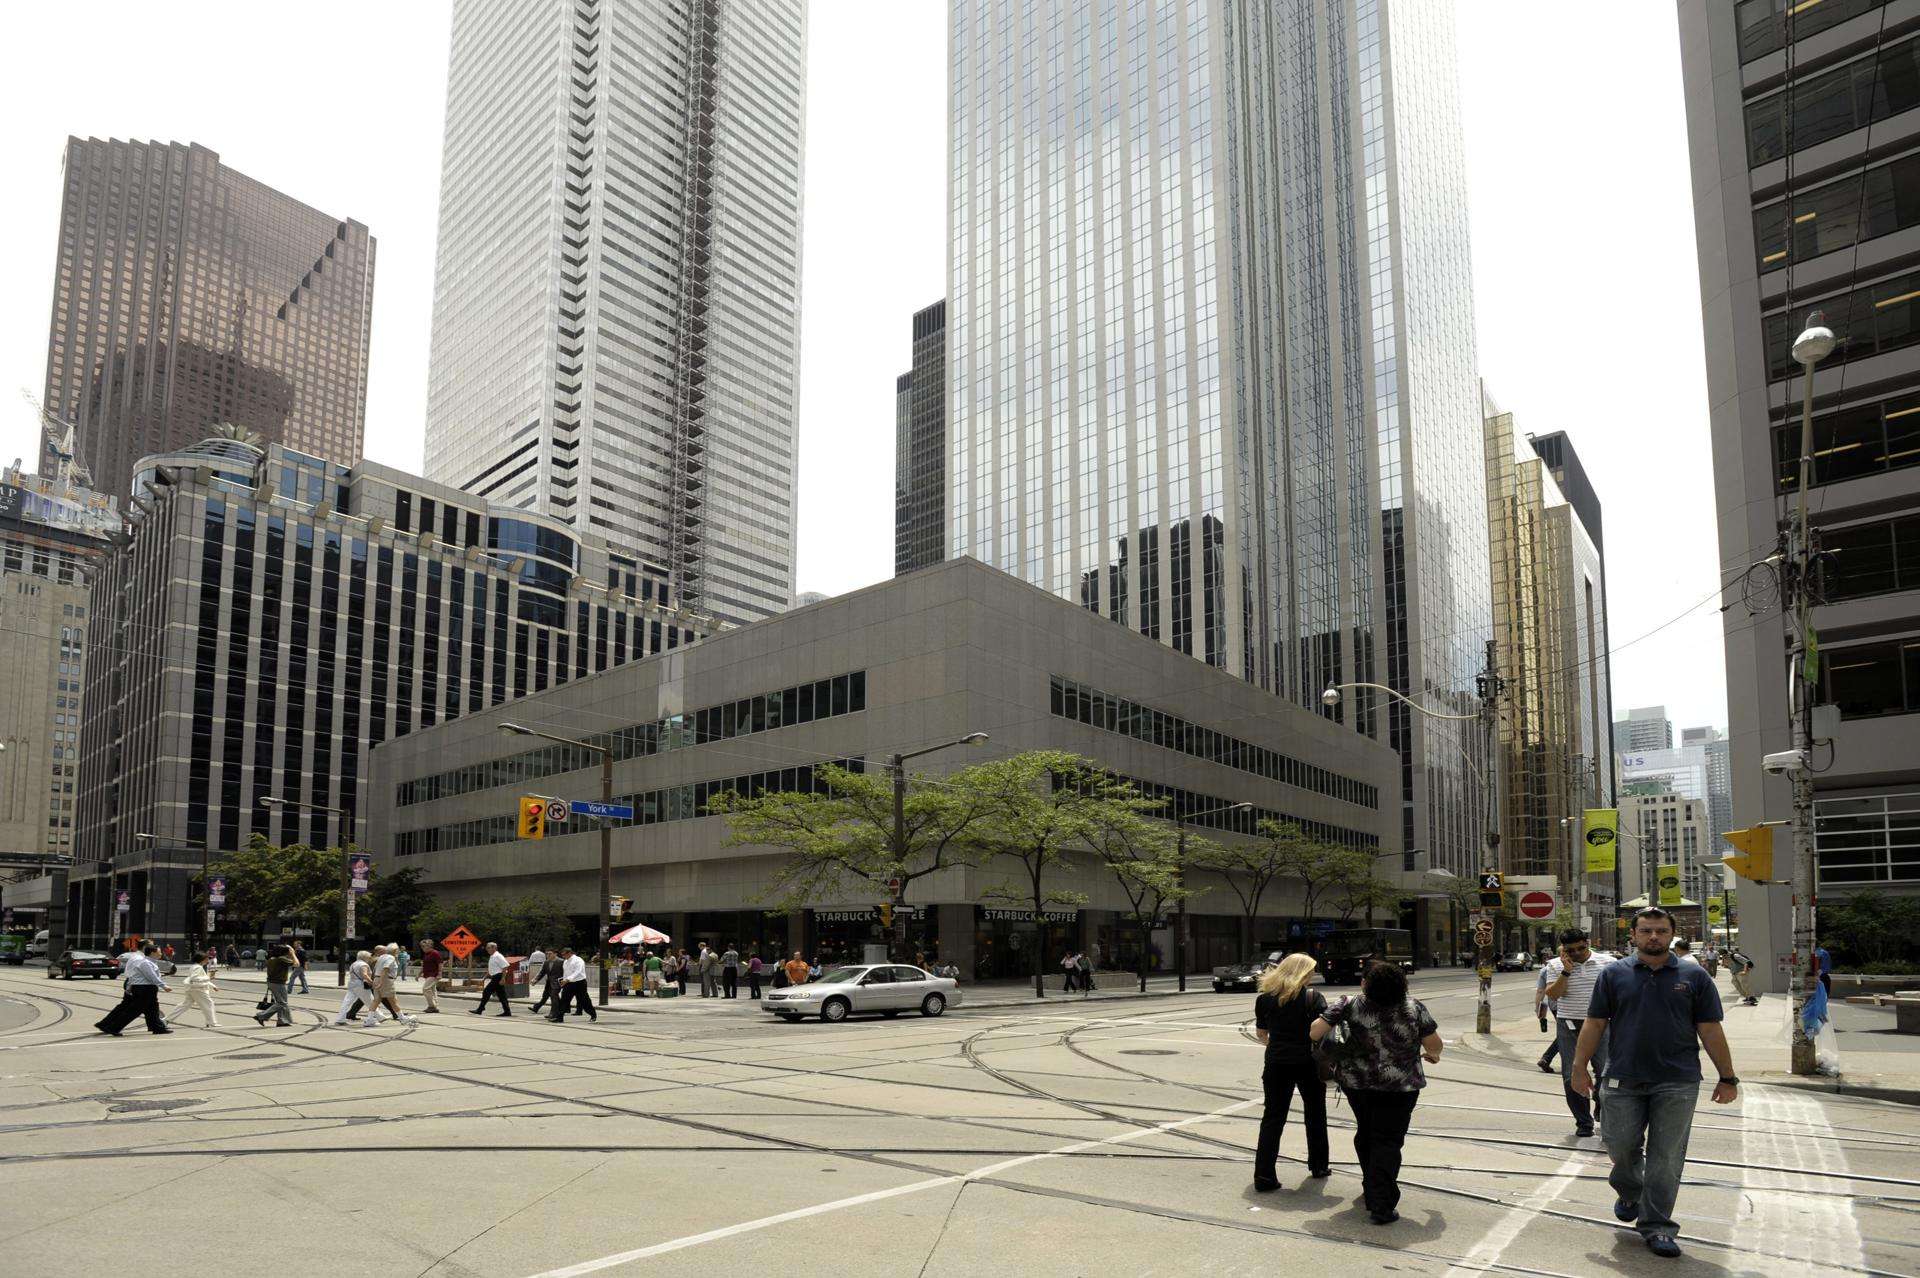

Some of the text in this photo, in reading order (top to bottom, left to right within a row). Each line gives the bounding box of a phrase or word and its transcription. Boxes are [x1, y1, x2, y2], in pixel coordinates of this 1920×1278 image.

[588, 804, 607, 814] York
[985, 910, 1076, 922] STARBUCK COFFEE
